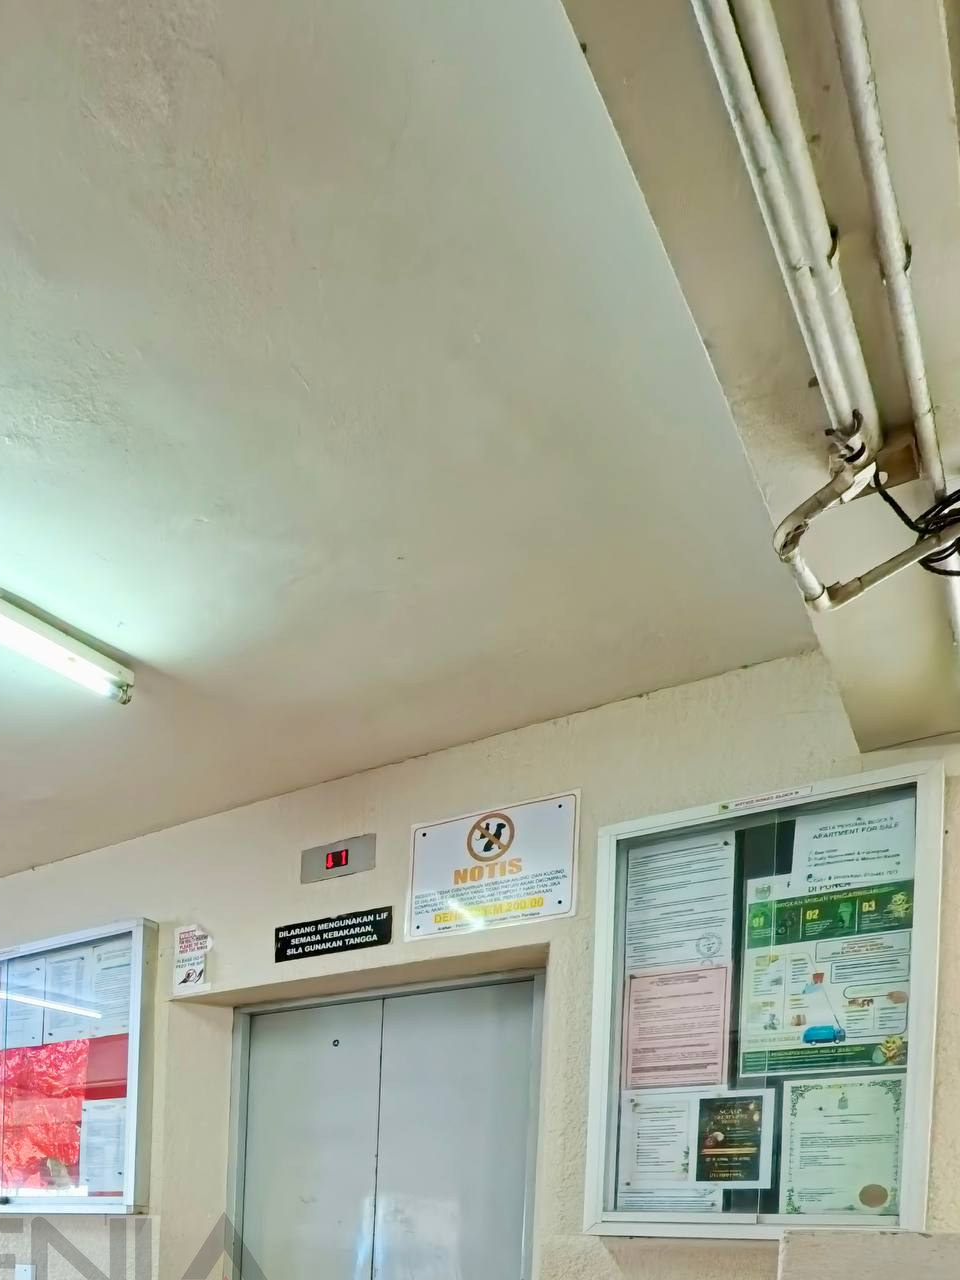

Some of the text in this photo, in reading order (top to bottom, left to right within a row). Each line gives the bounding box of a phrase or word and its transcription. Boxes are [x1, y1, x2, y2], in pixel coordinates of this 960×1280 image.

[812, 821, 900, 840] APARTMENT FOR SALE
[453, 858, 523, 886] NOTIS
[806, 909, 819, 920] 02
[861, 900, 876, 912] 03
[278, 912, 389, 938] DILARANG MENGUNAKAN LIF
[290, 925, 374, 945] SEMASA KEBAKARAN,
[286, 934, 378, 956] SILA GUNAKAN TANGGA
